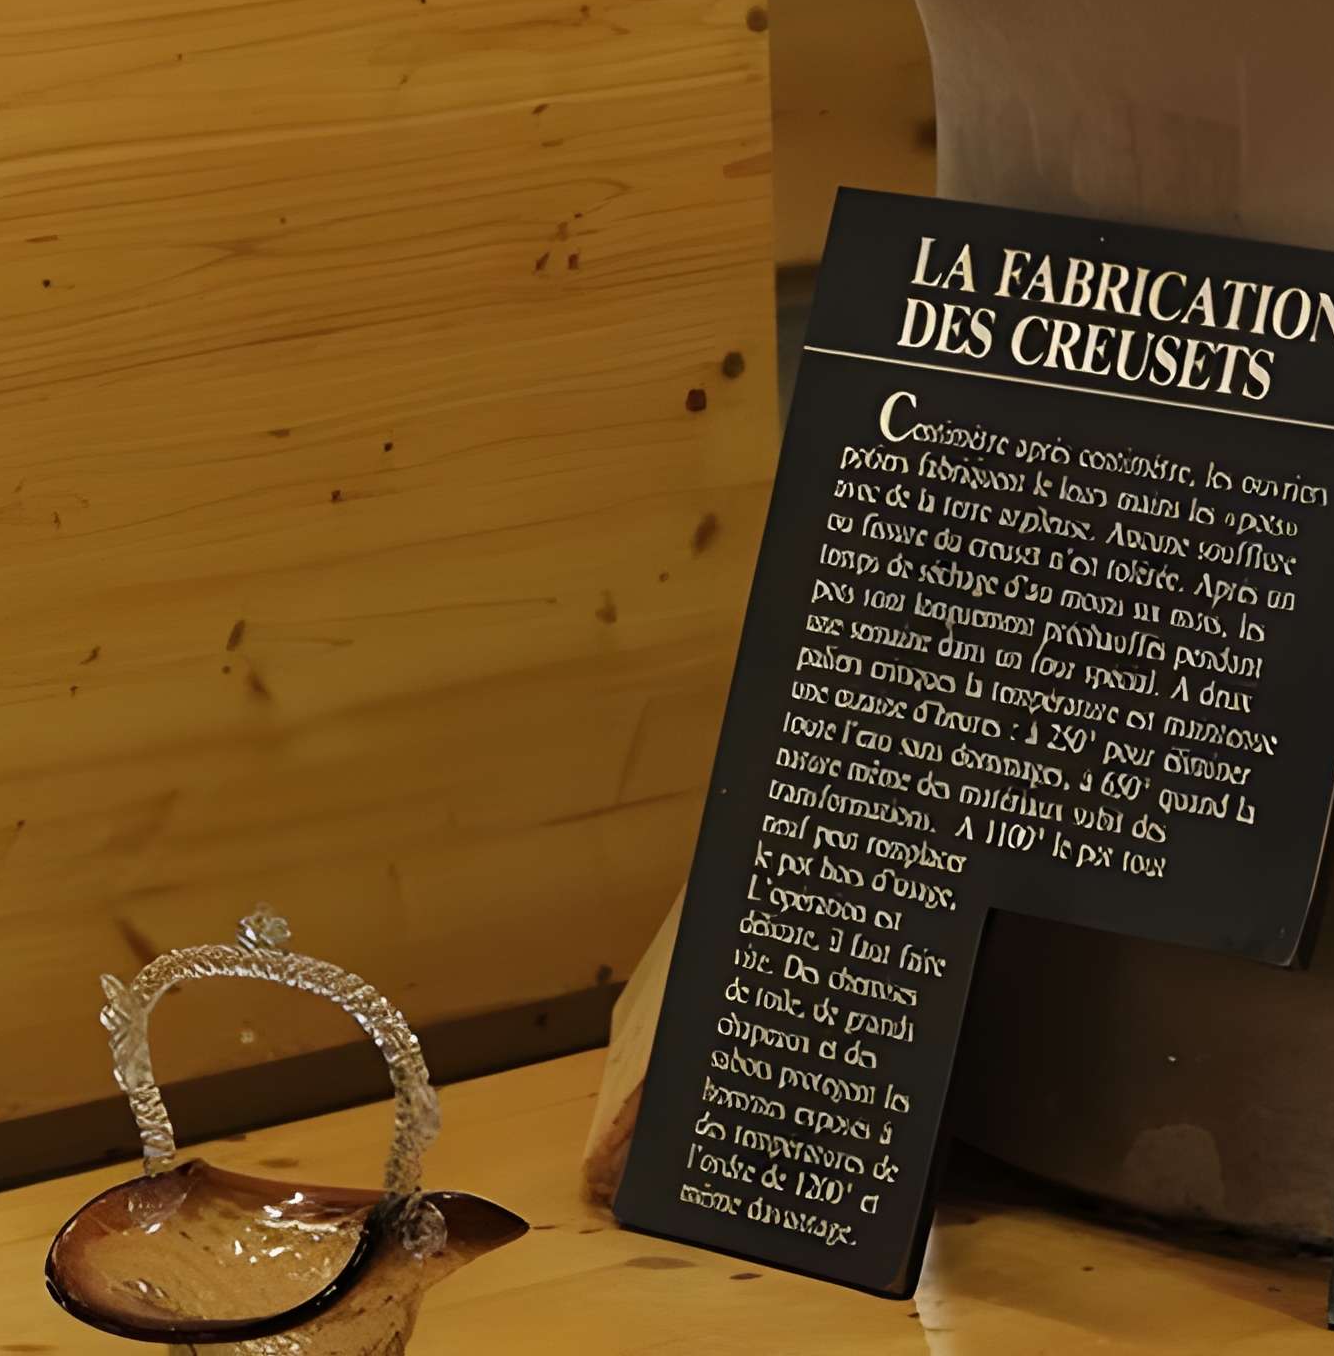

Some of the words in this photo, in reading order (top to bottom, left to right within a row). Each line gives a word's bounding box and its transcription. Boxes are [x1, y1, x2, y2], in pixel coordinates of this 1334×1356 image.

[911, 236, 976, 293] LA
[897, 297, 996, 359] DES
[1010, 315, 1275, 401] CREUSETS
